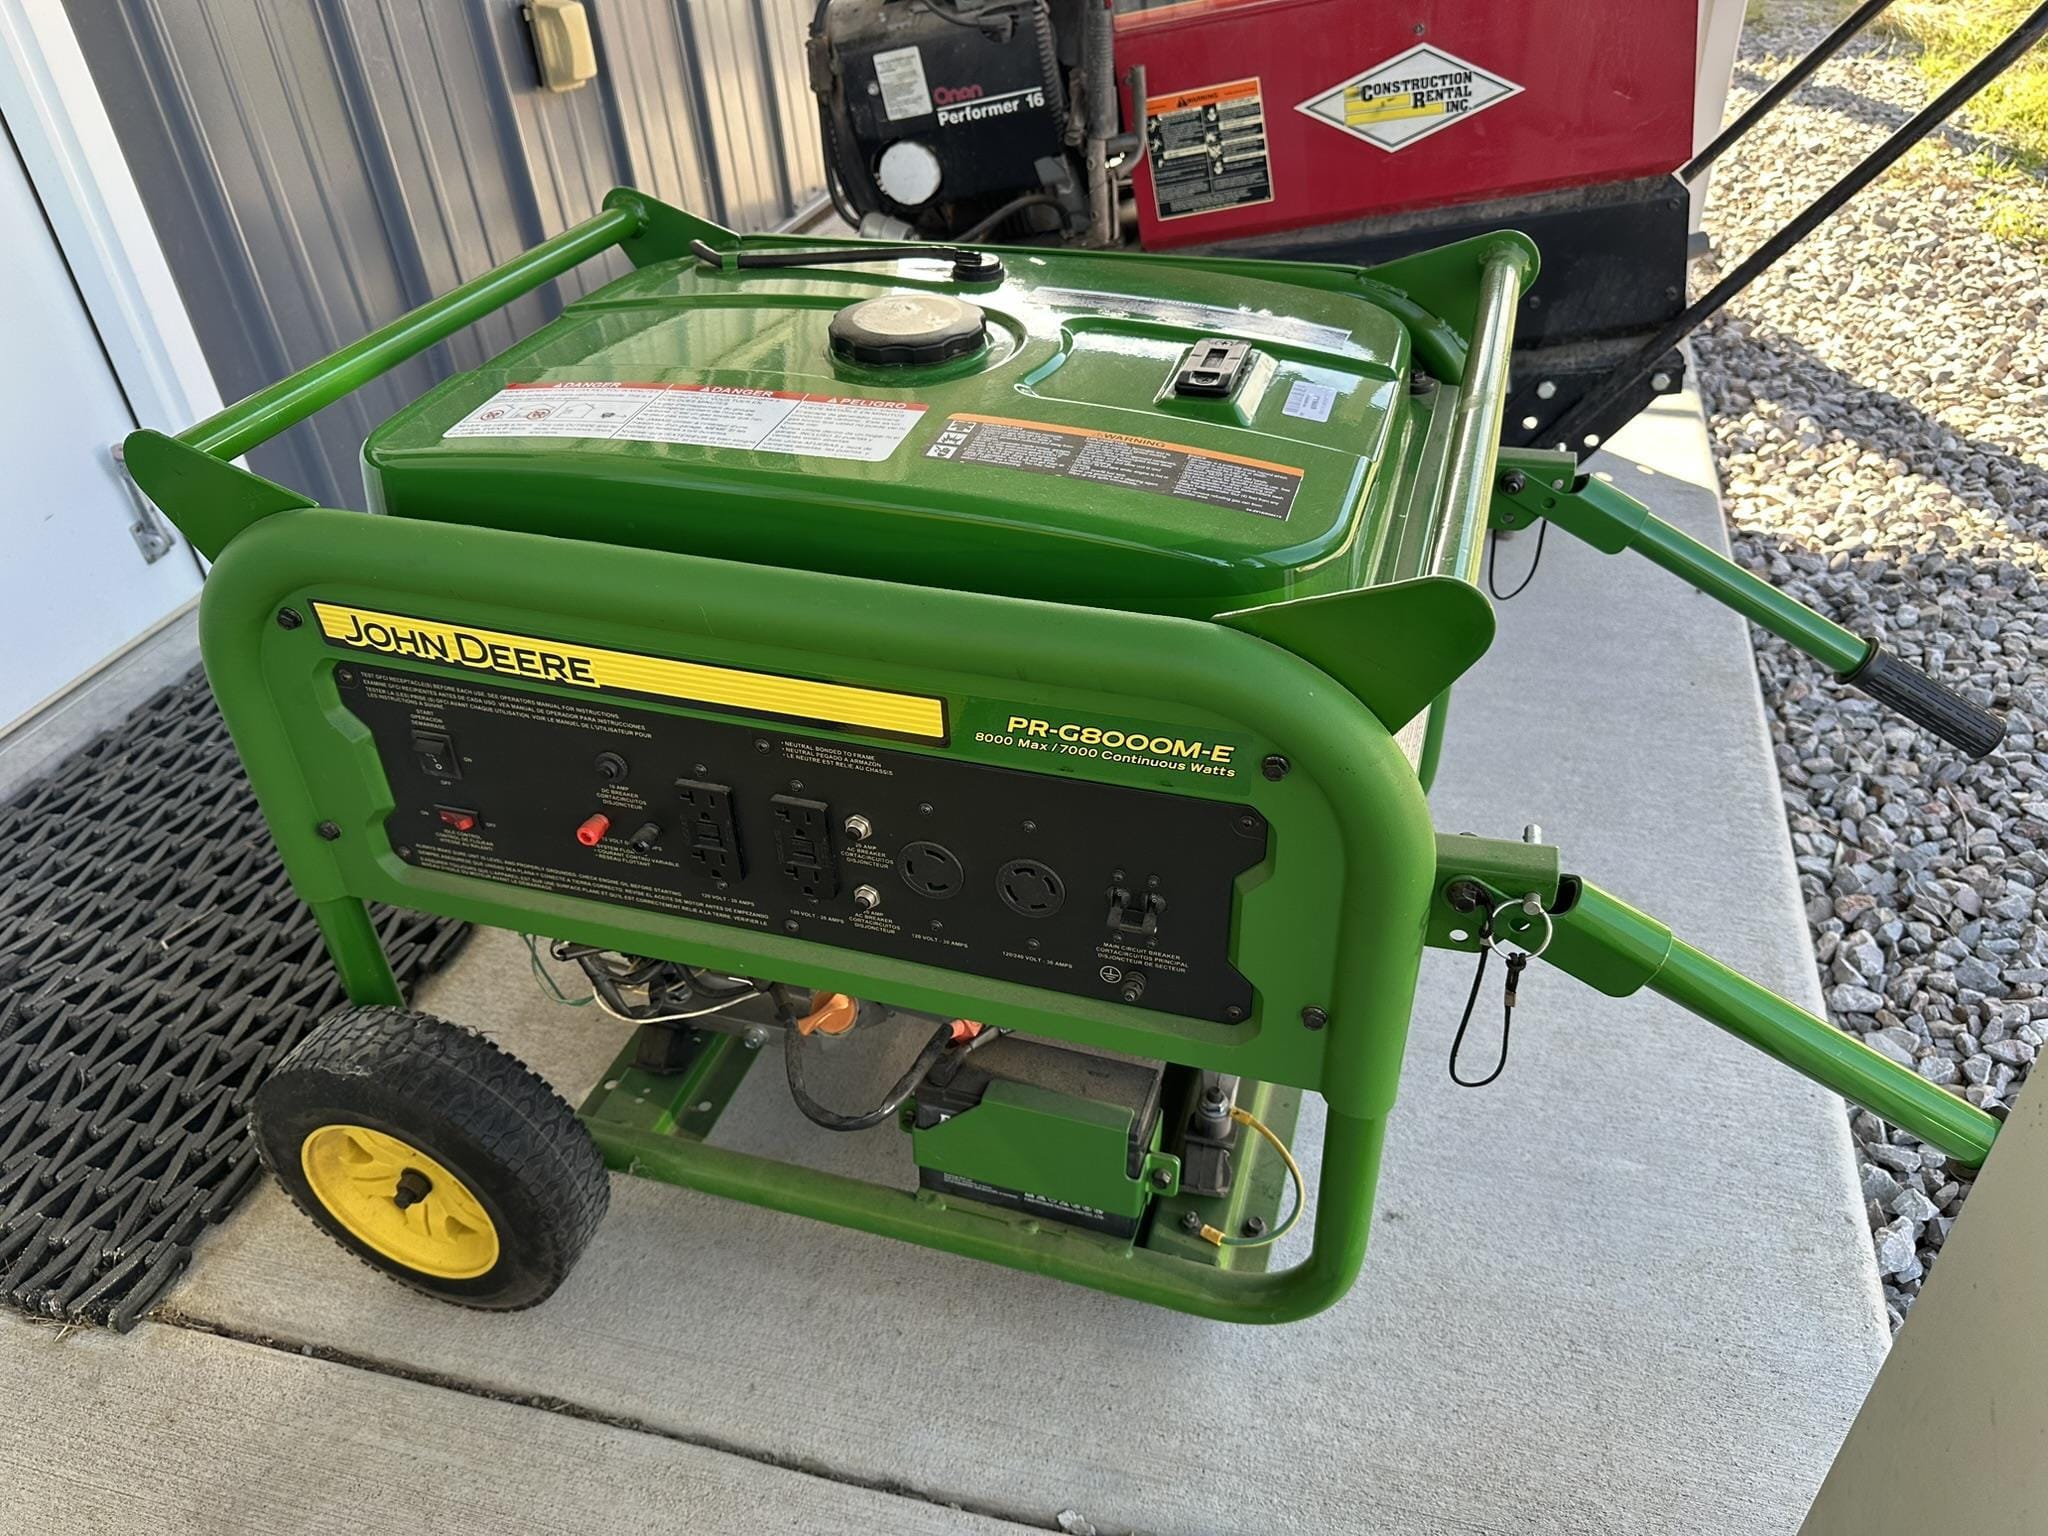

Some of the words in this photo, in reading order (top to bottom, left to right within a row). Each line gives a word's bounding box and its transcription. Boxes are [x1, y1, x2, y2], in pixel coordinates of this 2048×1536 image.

[1361, 71, 1472, 102] CONSTRUCTION
[933, 85, 983, 104] Onan
[1412, 85, 1472, 109] RENTAL
[937, 99, 1020, 127] Performer
[1025, 92, 1045, 109] 16
[1445, 98, 1473, 114] INC.
[710, 387, 773, 398] DANGER
[840, 398, 907, 409] PELIGRO
[1104, 433, 1166, 448] WARNING
[345, 614, 450, 659] JOHN
[455, 632, 597, 684] DEERE
[432, 683, 456, 692] BEFORE
[456, 687, 472, 695] EACH
[536, 700, 561, 710] MANUAL
[415, 708, 433, 716] START
[510, 703, 535, 713] MANUAL
[545, 708, 578, 720] OPERADOR
[579, 714, 596, 723] PARA
[555, 717, 580, 727] MANUEL
[634, 730, 652, 739] POUR
[1006, 715, 1235, 764] PR-G8000M-E
[784, 740, 814, 751] NEUTRAL
[815, 745, 842, 755] BONDED
[852, 751, 875, 760] FRAME
[785, 746, 815, 757] NEUTRAL
[815, 751, 843, 761] PEGADO
[975, 732, 1013, 747] 8000
[1018, 738, 1048, 752] Max
[1059, 744, 1098, 758] 7000
[1101, 750, 1186, 772] Continuous
[1190, 761, 1236, 778] Watts
[795, 754, 821, 764] NEUTRE
[610, 788, 639, 799] BREAKER
[856, 847, 886, 857] BREAKER
[846, 856, 888, 869] DISJONCTEUR
[630, 882, 653, 892] BEFORE
[711, 893, 726, 902] VOLT
[738, 898, 755, 906] AMPS
[683, 898, 704, 908] MOTOR
[705, 902, 725, 911] ANTES
[733, 907, 769, 919] EMPEZANDO
[800, 909, 815, 918] VOLT
[827, 914, 844, 923] AMPS
[864, 913, 893, 923] BREAKER
[854, 921, 895, 934] DISJONCTEUR
[921, 934, 938, 943] VOLT
[950, 939, 968, 948] AMPS
[1095, 945, 1153, 961] CORTACIRCUITOS
[1153, 954, 1189, 967] PRINCIPAL
[1103, 941, 1120, 950] MAIN
[1120, 944, 1147, 954] CIRCUIT
[1147, 948, 1181, 960] BREAKER
[1025, 954, 1041, 963] VOLT
[1054, 958, 1072, 967] AMPS
[1097, 952, 1142, 966] DISJONCTEUR
[1153, 961, 1186, 972] SECTEUR
